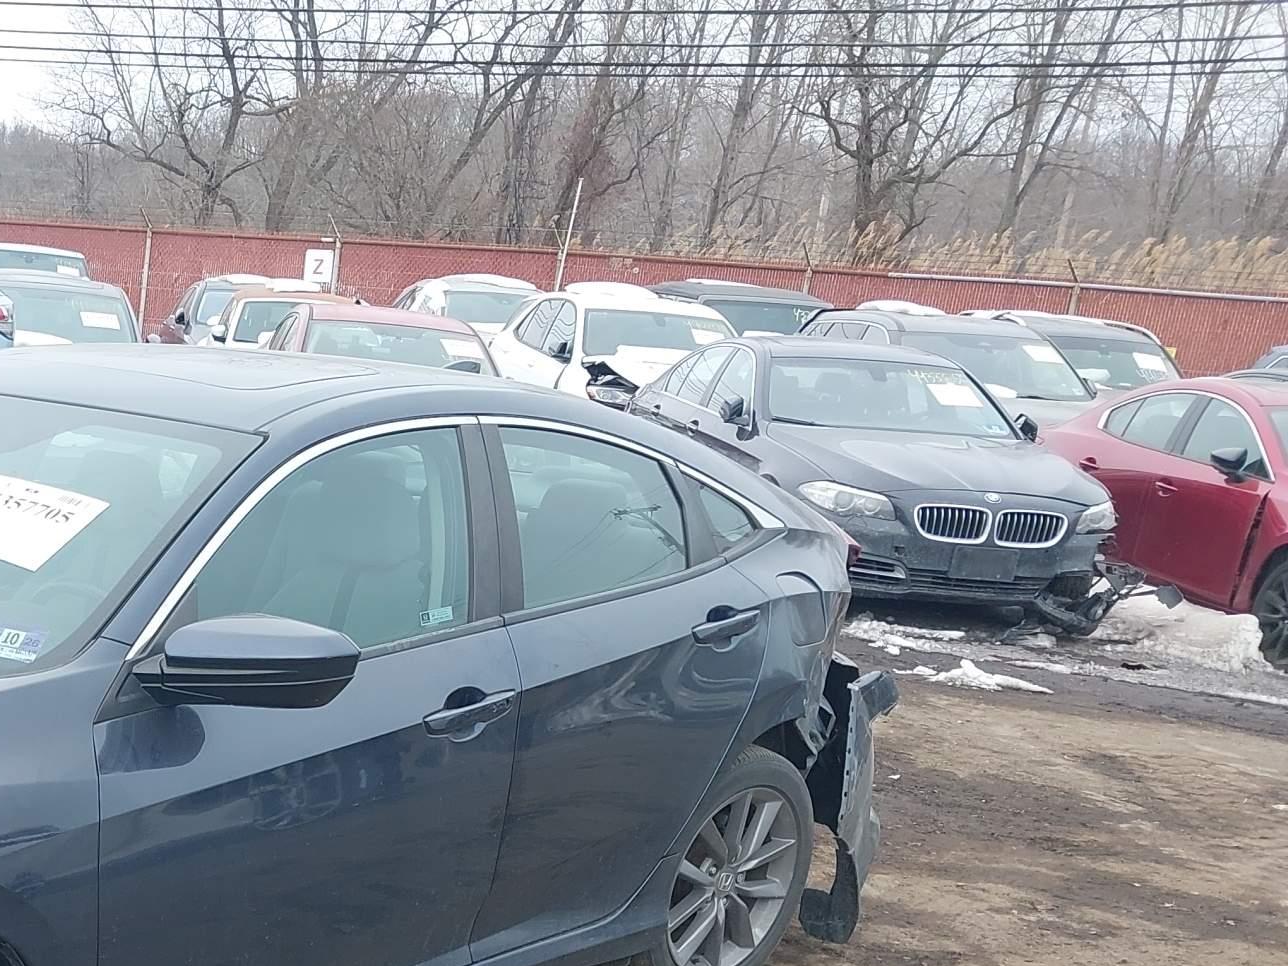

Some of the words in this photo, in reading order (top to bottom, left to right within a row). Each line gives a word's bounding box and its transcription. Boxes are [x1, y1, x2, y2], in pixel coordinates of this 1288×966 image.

[312, 258, 324, 275] Z
[1, 631, 20, 646] 10
[24, 637, 41, 648] 26
